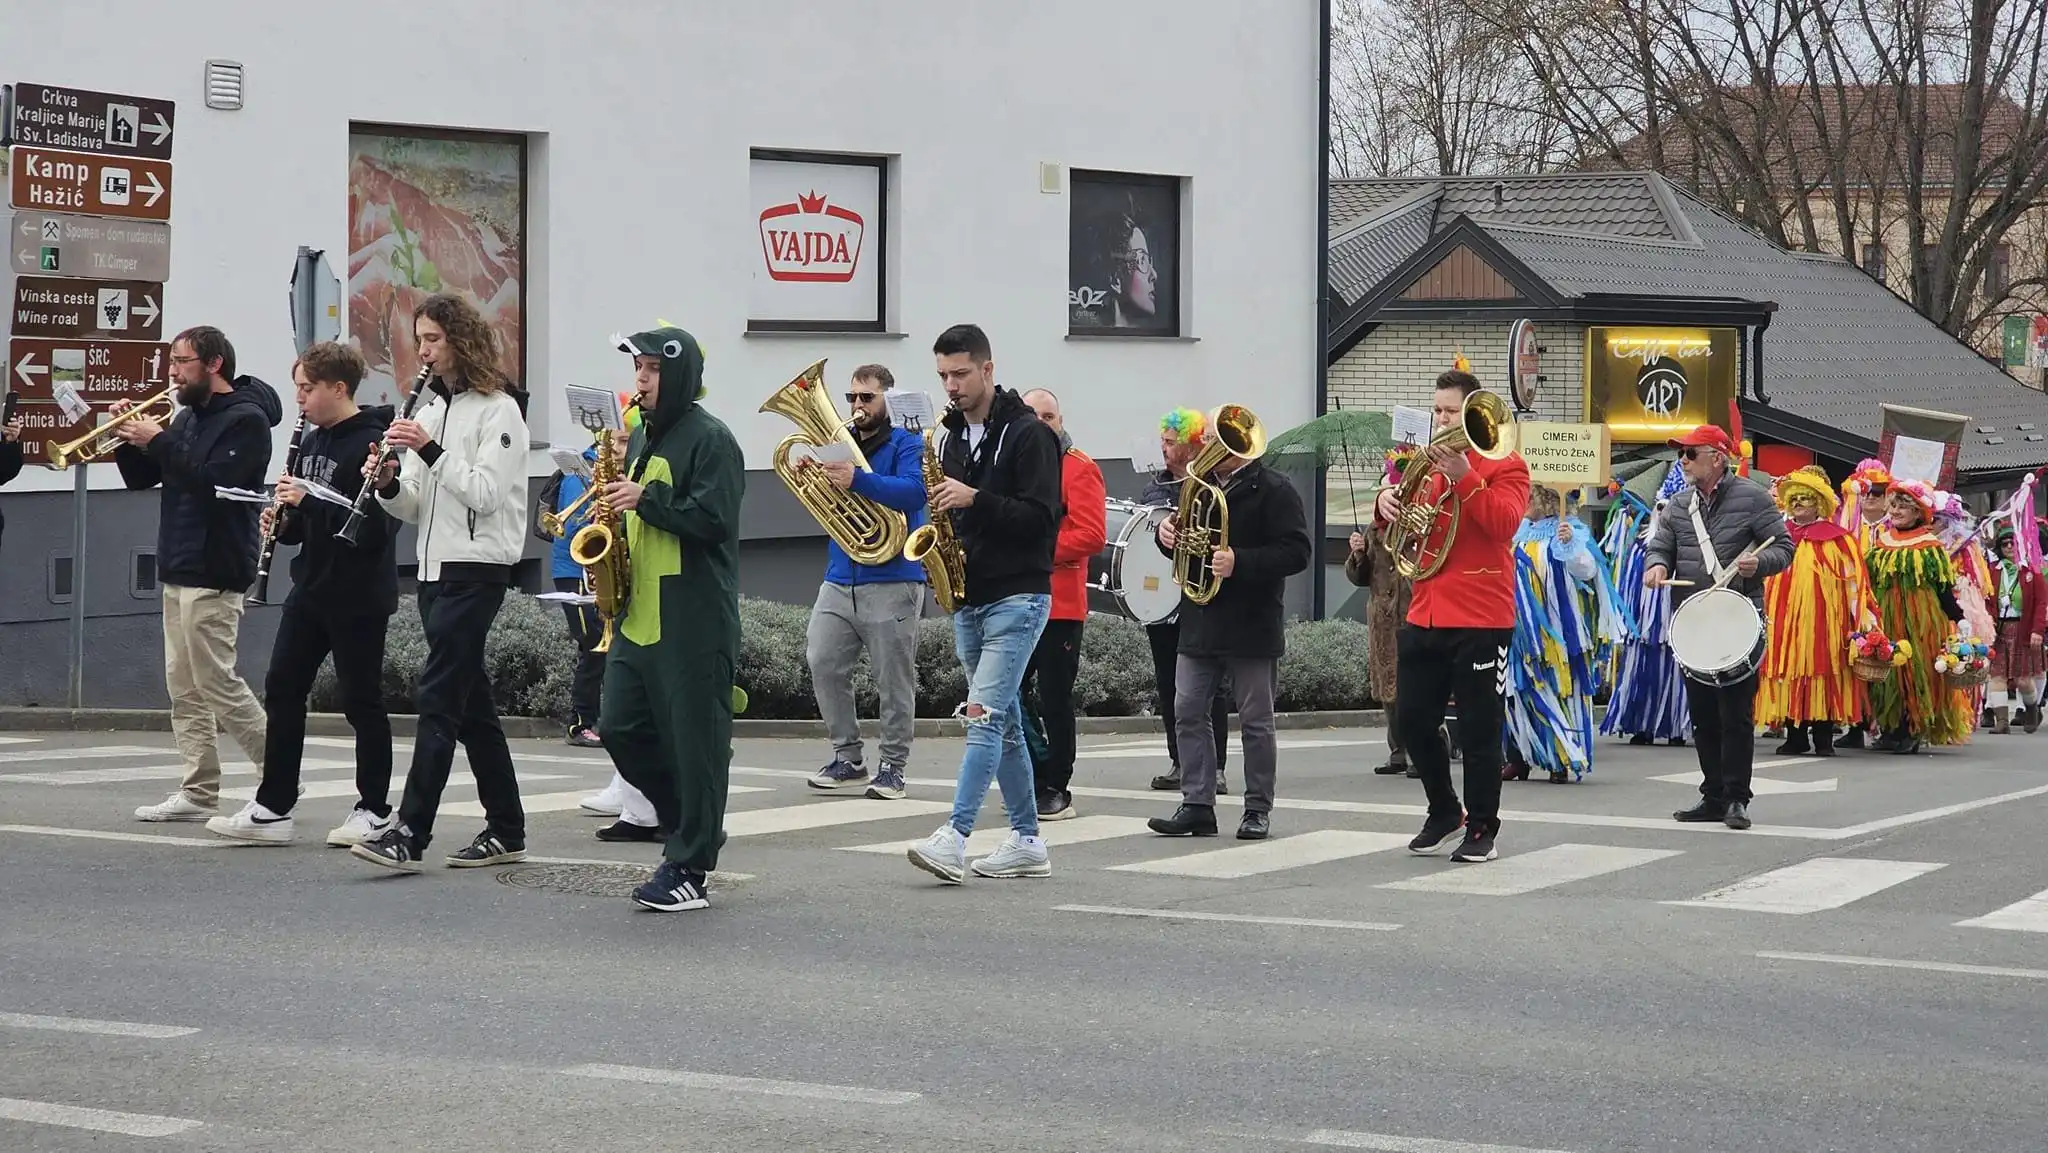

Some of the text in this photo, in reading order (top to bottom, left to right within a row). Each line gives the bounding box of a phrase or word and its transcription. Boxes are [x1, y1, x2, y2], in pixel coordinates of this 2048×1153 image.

[42, 89, 78, 107] Crkva
[17, 105, 105, 132] Kraljice Marije
[16, 127, 103, 150] i Sv. Ladislava
[26, 154, 89, 185] Kamp
[30, 184, 84, 207] Hažić
[65, 222, 100, 241] Spomen
[107, 227, 124, 240] dom
[127, 229, 166, 244] rudarstva
[768, 230, 852, 266] VAJDA
[20, 289, 95, 305] Vinska cesta
[18, 310, 79, 325] Wine road
[88, 345, 110, 366] ŠRC
[1613, 337, 1713, 366] Caffe bar
[88, 374, 129, 392] Zalešće
[1644, 379, 1683, 421] ART
[17, 411, 55, 428] etnica
[1542, 432, 1578, 441] CIMERI
[1524, 447, 1595, 458] DRUŠTVO ŽENA
[1531, 463, 1540, 471] M.
